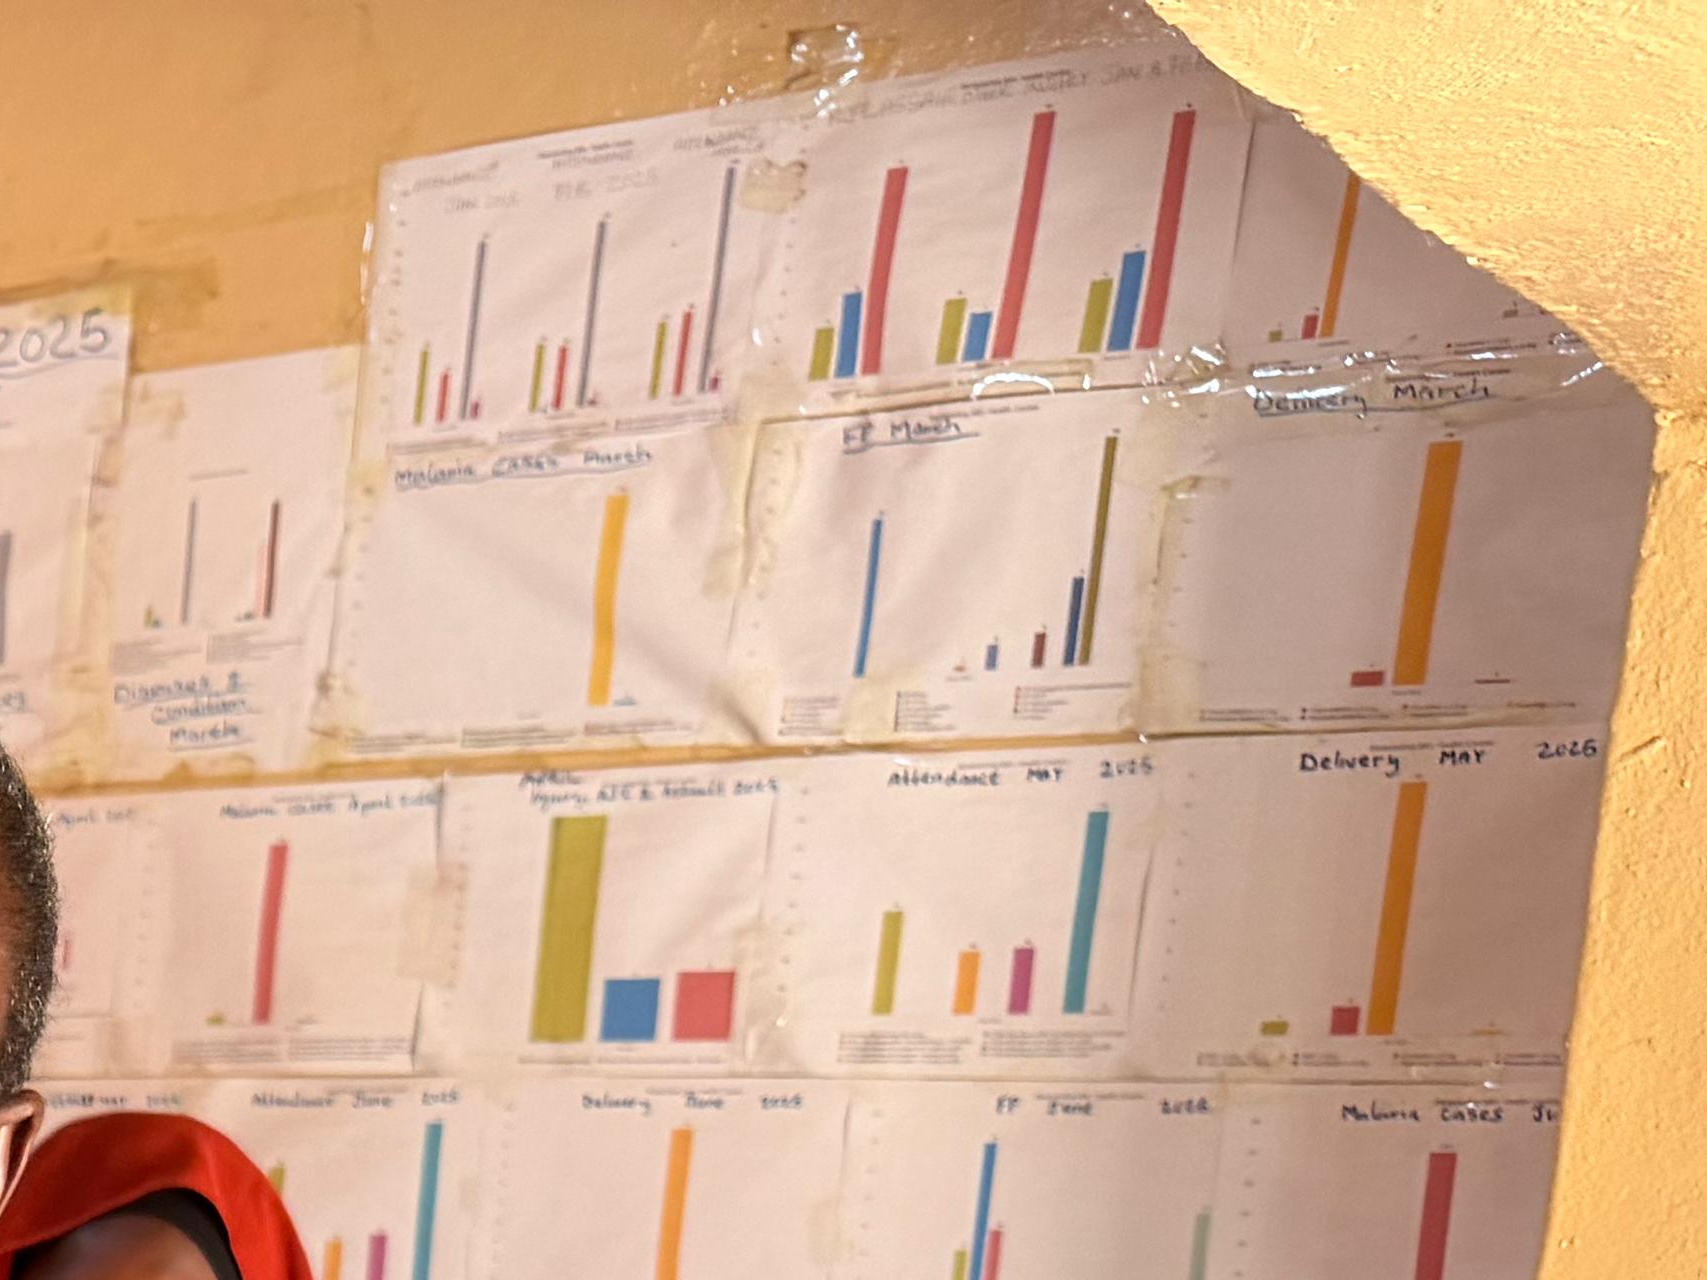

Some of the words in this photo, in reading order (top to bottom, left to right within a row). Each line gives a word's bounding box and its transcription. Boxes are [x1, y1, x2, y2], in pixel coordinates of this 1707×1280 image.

[1393, 377, 1490, 401] March
[889, 416, 963, 440] March
[1299, 749, 1401, 789] Delivery
[1439, 749, 1487, 766] MAY
